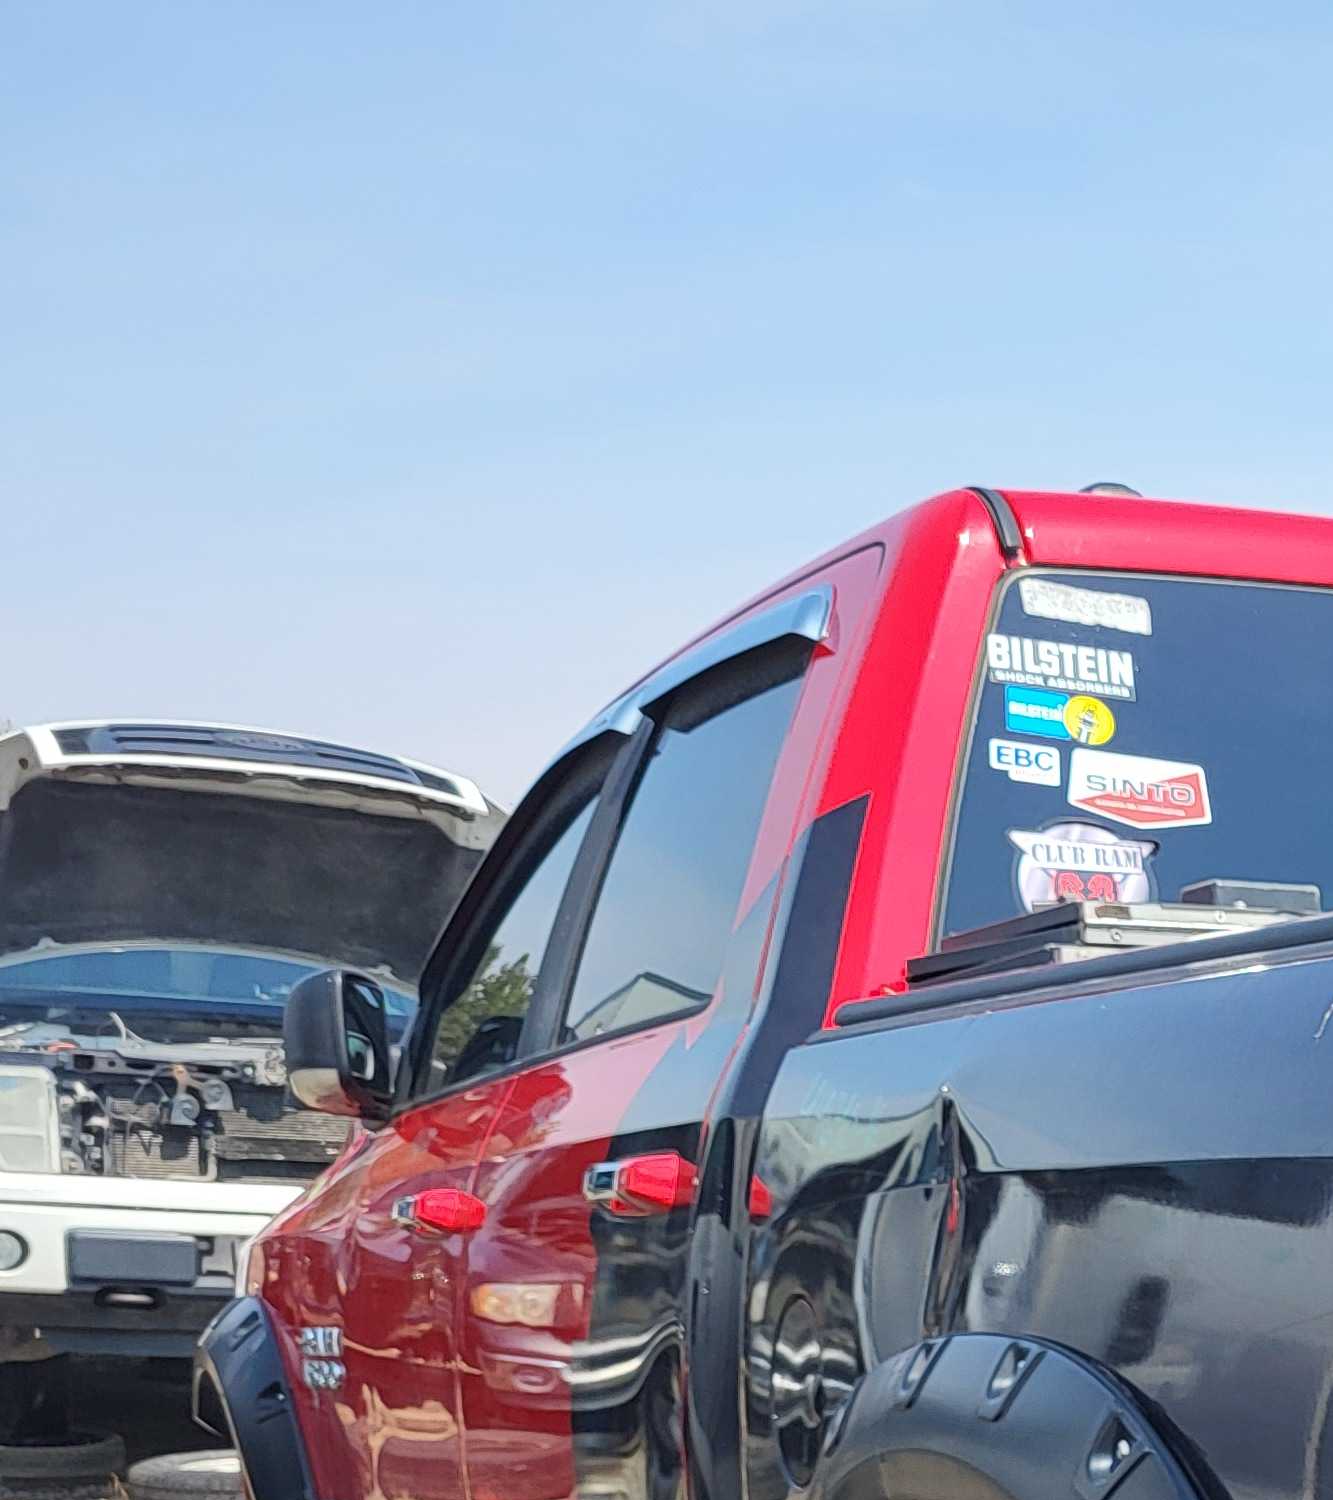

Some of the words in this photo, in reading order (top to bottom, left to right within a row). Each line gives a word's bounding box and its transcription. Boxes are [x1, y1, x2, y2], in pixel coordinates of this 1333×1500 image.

[987, 632, 1134, 688] BILSTEIN
[995, 744, 1054, 772] EBC
[1085, 773, 1195, 806] SINTO
[1031, 843, 1086, 866] CLUB
[1094, 847, 1141, 870] RAM
